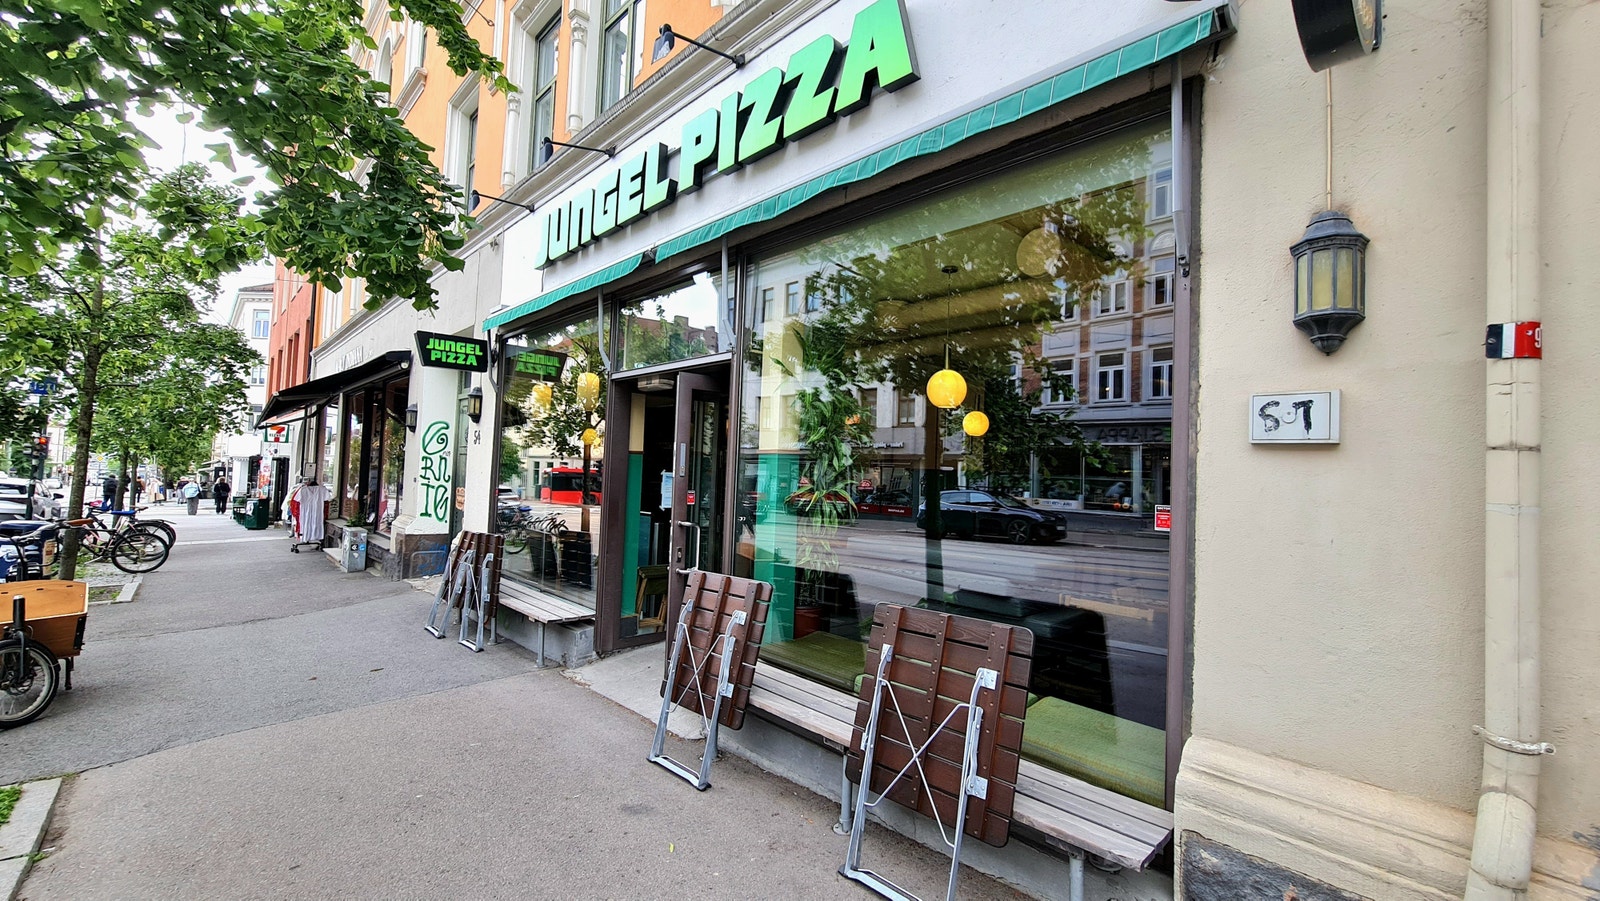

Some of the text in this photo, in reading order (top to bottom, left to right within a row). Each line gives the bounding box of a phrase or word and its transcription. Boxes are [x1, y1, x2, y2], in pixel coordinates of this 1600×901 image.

[535, 0, 916, 269] JUNGEL PIZZA
[426, 338, 483, 356] JUNGEL
[430, 350, 478, 366] PIZZA
